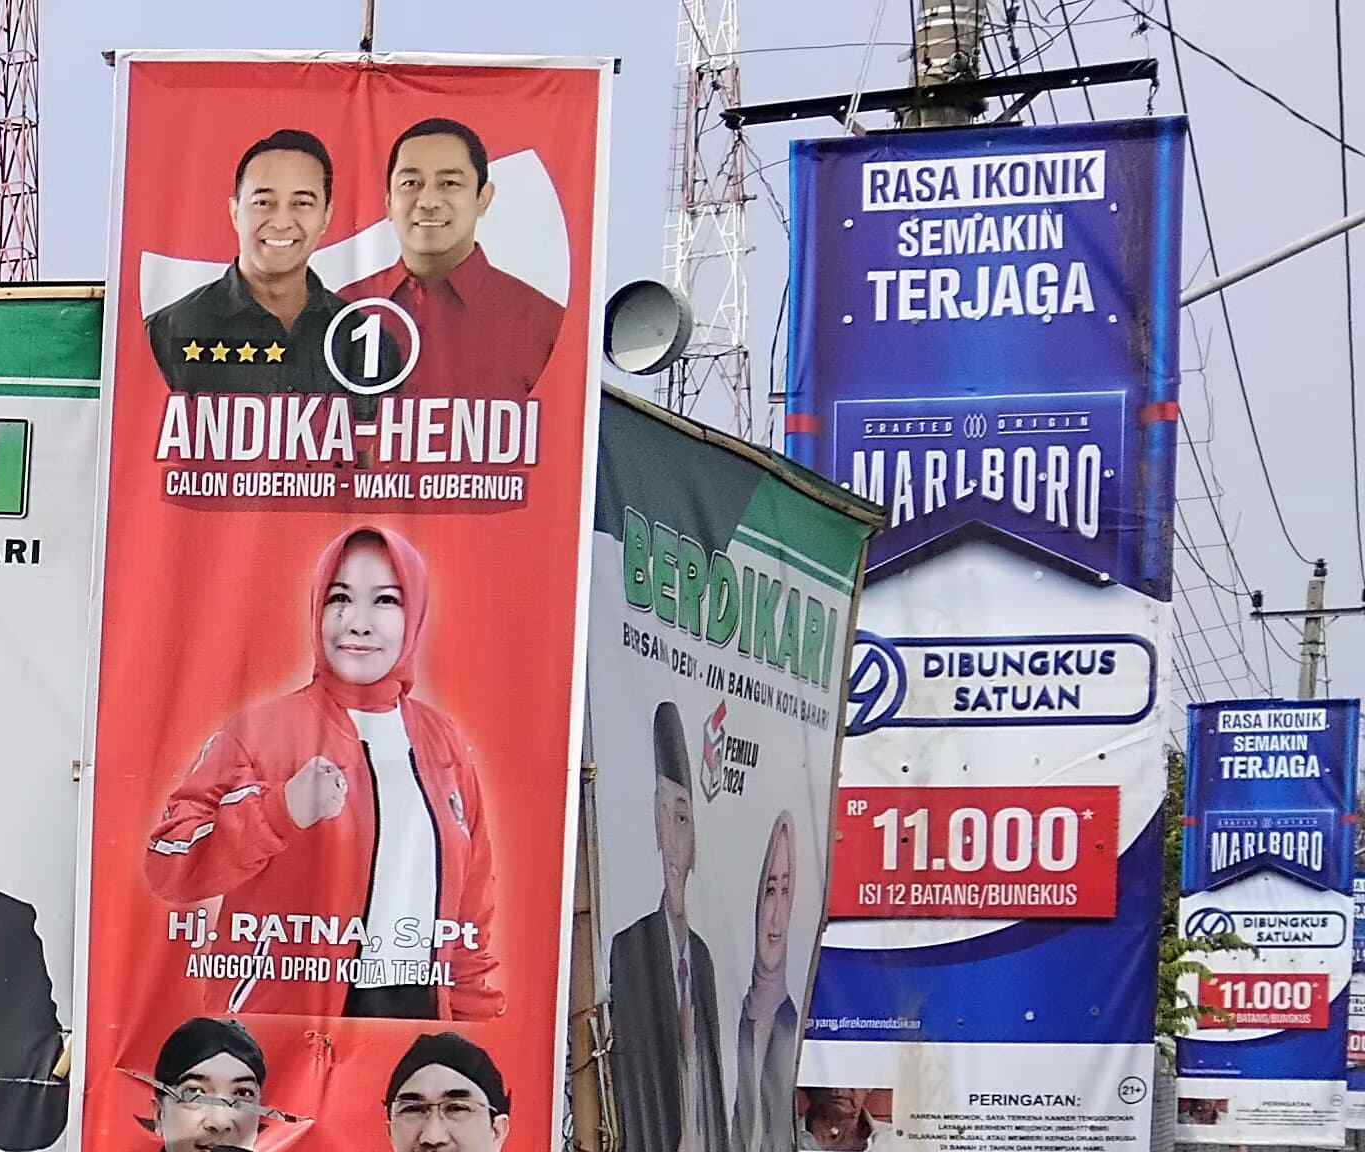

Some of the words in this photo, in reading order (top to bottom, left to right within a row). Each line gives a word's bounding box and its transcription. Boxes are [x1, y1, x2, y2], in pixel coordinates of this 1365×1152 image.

[869, 166, 960, 204] RASA
[972, 156, 1098, 199] IKONIK
[897, 213, 1064, 258] SEMAKIN
[867, 262, 1095, 323] TERJAGA
[350, 313, 380, 378] 1
[156, 395, 539, 465] ANDIKA-HENDI
[865, 421, 953, 434] CRAFTED
[166, 470, 229, 496] CALON
[232, 471, 334, 498] GUBERNUR
[354, 473, 414, 499] WAKIL
[419, 474, 524, 501] GUBERNUR
[852, 444, 1101, 539] MARLBORO
[623, 505, 838, 693] BERDIKARI
[923, 649, 1117, 679] DIBUNGKUS
[706, 664, 725, 691] IIN
[728, 672, 773, 708] BANGUN
[775, 690, 798, 719] KOTA
[954, 684, 1081, 712] SATUAN
[1222, 714, 1261, 729] RASA
[1268, 712, 1323, 728] IKONIK
[725, 735, 759, 768] PEMILU
[1233, 735, 1308, 752] SEMAKIN
[722, 766, 745, 796] 2024
[1220, 755, 1320, 779] TERJAGA
[847, 800, 868, 816] RP
[1211, 831, 1324, 873] MARLBORO
[859, 884, 882, 905] ISI
[886, 884, 906, 905] 12
[910, 883, 1077, 909] BATANG/BUNGKUS
[167, 910, 218, 948] Hj.
[231, 913, 382, 948] RATNA,
[393, 917, 479, 950] S.Pt
[1243, 917, 1329, 928] DIBUNGKUS
[1257, 931, 1313, 942] SATUAN
[186, 954, 275, 981] ANGGOTA
[280, 956, 331, 982] DPRD
[336, 958, 386, 985] KOTA
[393, 960, 456, 987] TEGAL
[969, 1093, 1081, 1107] PERINGATAN:
[1122, 1085, 1142, 1096] 21+
